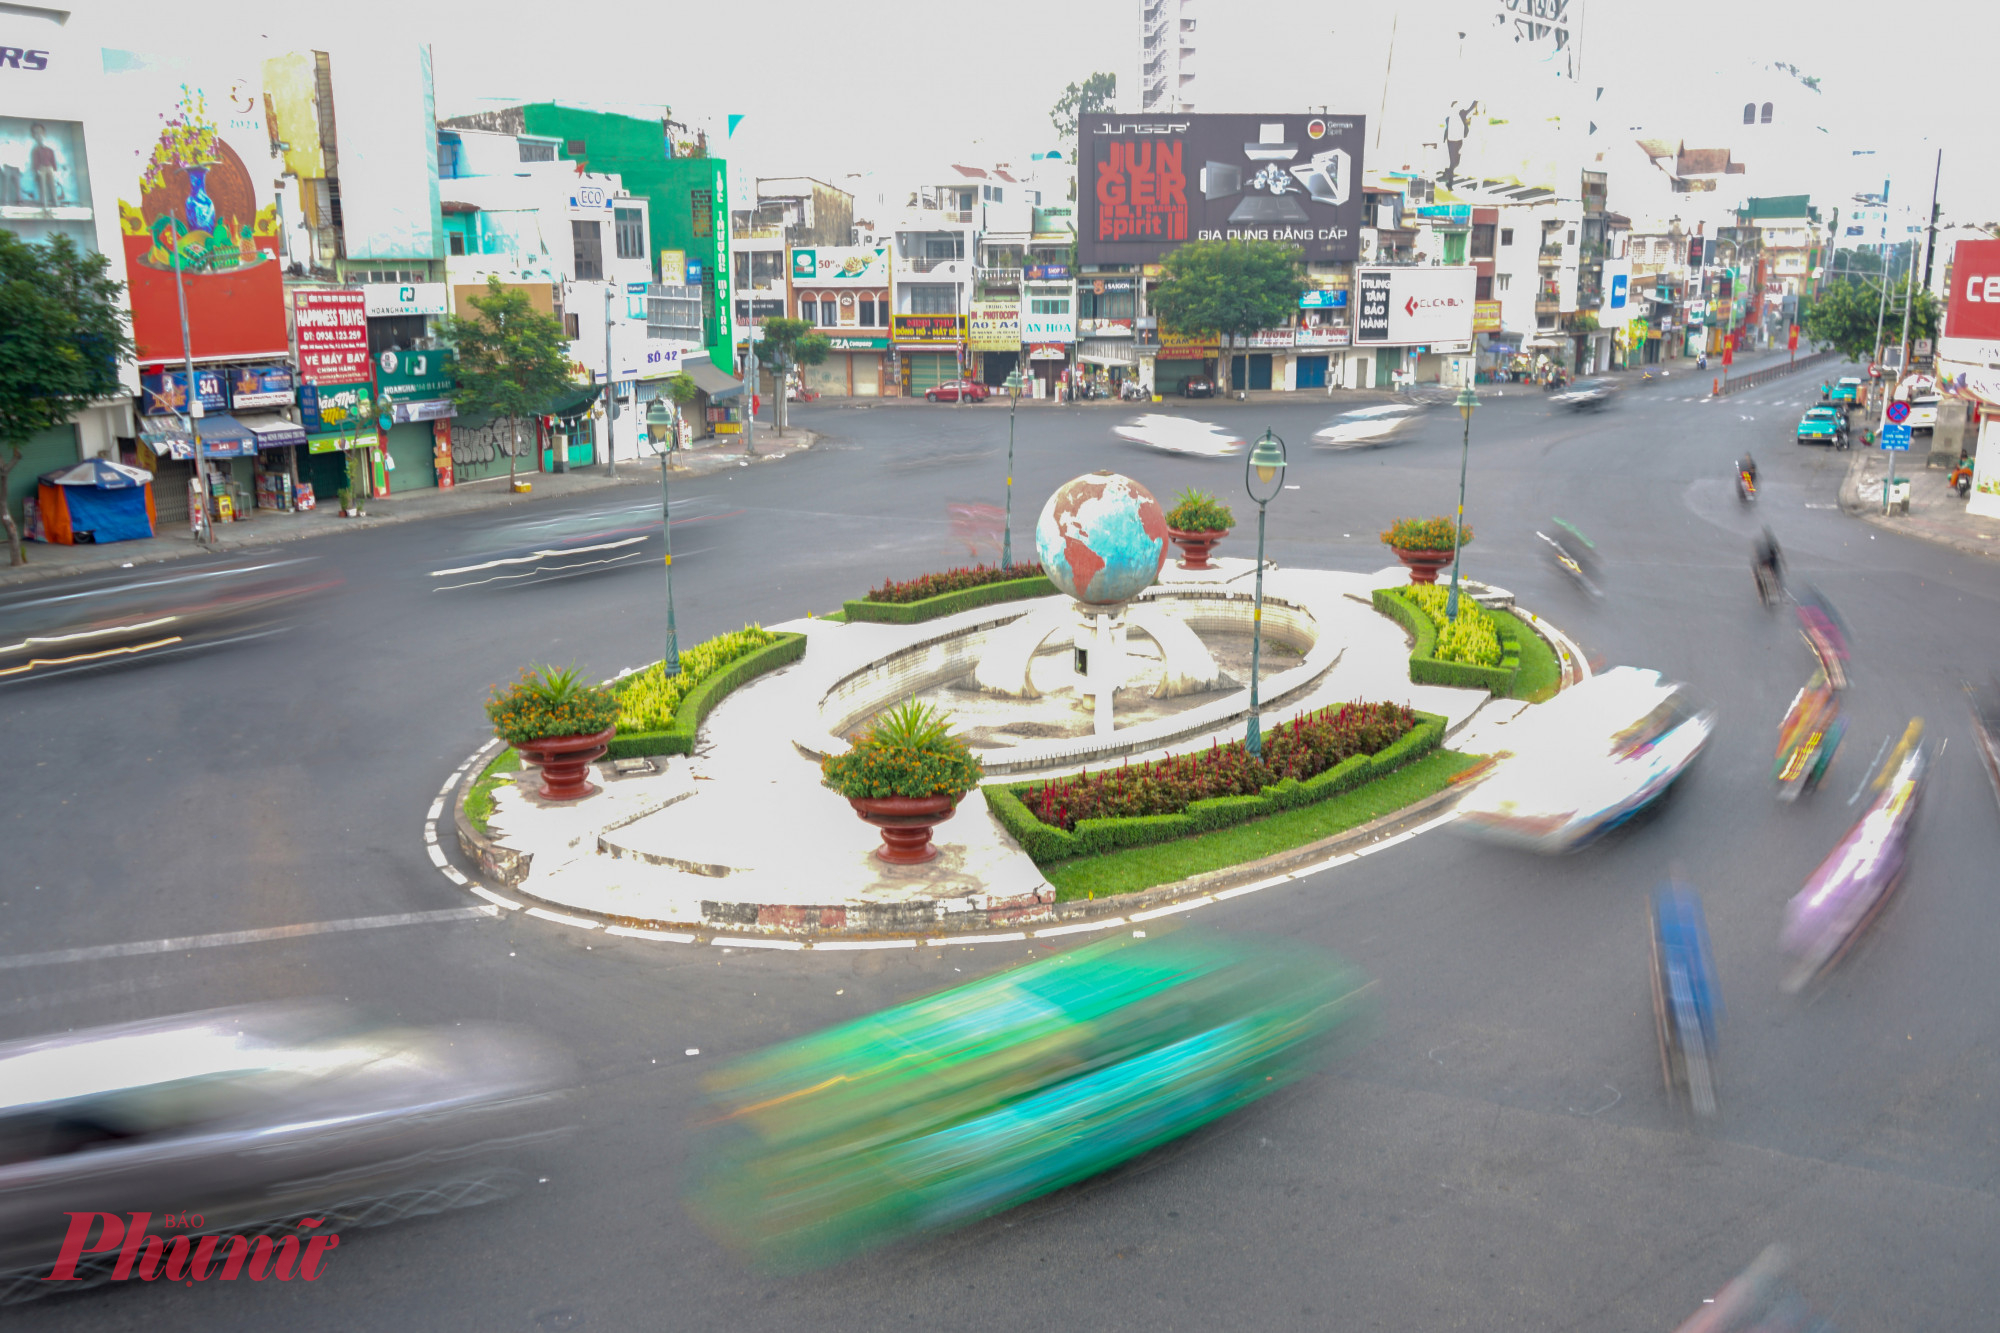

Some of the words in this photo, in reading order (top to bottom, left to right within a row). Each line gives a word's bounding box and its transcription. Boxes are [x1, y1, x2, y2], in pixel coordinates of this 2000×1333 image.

[1094, 123, 1187, 134] JUNGER
[1327, 121, 1353, 129] German
[1098, 140, 1183, 174] JUN
[1097, 173, 1187, 206] GER
[581, 190, 602, 204] ECO
[1104, 213, 1162, 240] spirit
[1198, 230, 1222, 241] GIA
[1317, 225, 1348, 241] CẤP
[1361, 279, 1391, 289] TRUNG
[1365, 289, 1386, 302] TÂM
[983, 310, 1019, 320] PHOTOCOPY
[1364, 302, 1386, 315] BẢO
[297, 309, 338, 327] HAPPINESS
[338, 308, 366, 326] TRAVEL
[907, 319, 931, 327] MINH
[1360, 316, 1388, 329] HÀNH
[896, 325, 915, 336] ĐỒNG
[1026, 323, 1041, 332] AN
[321, 352, 343, 365] MÁY
[346, 352, 366, 364] BAY
[664, 351, 678, 361] 42
[199, 379, 218, 395] 341
